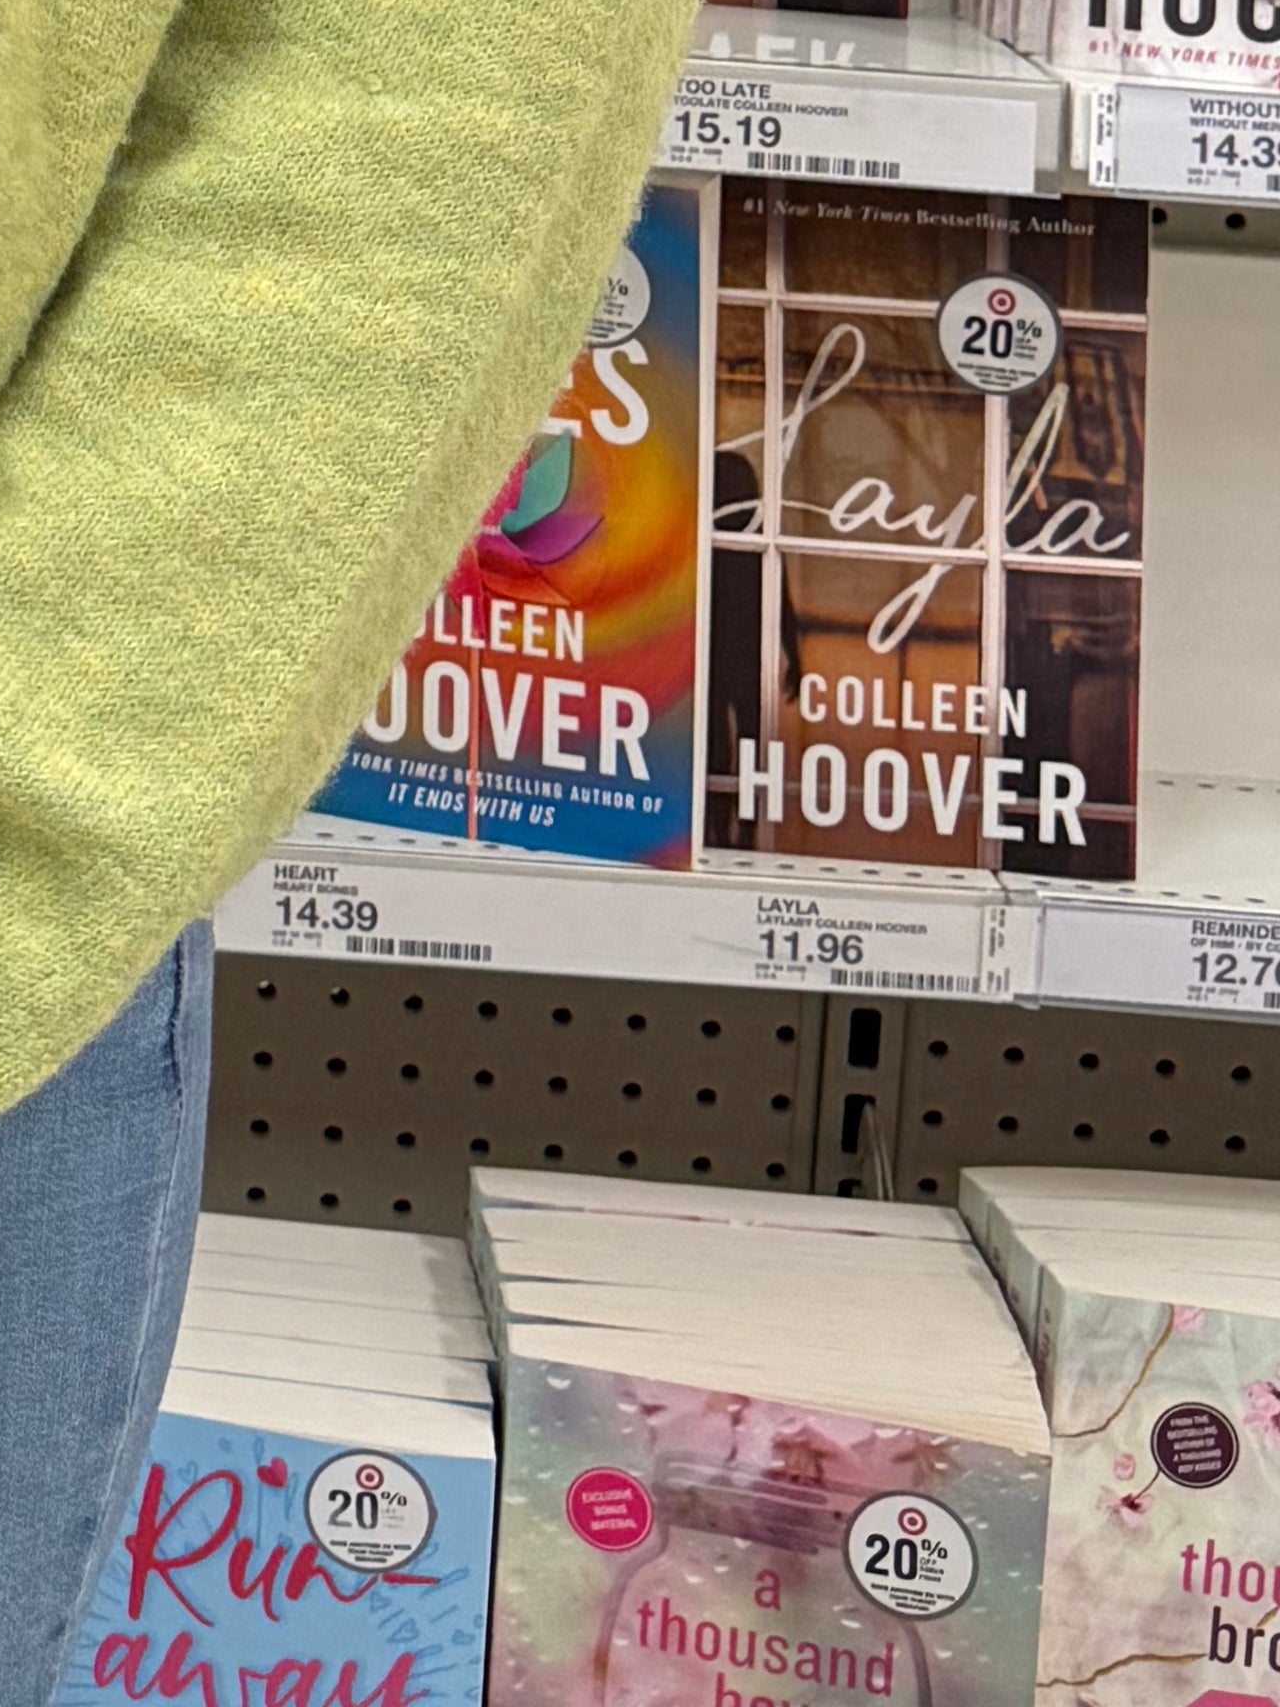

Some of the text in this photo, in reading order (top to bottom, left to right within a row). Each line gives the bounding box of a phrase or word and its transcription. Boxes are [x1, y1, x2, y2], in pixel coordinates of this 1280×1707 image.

[1122, 42, 1216, 63] NEW YORK
[722, 81, 770, 99] LATE
[733, 98, 848, 116] COLLEEN HOOVER
[674, 112, 781, 148] 15.19
[772, 201, 1096, 238] New York Times Bestselling Author
[962, 316, 1042, 359] 20%
[714, 323, 1130, 654] Layla
[800, 673, 1028, 738] COLLEEN
[388, 783, 555, 827] IT ENDS WITH US
[400, 759, 663, 814] TIMES BESTSELLING AUTHOR OF
[738, 736, 1088, 846] HOOVER
[275, 865, 337, 882] HEART
[276, 897, 377, 931] 14.39
[758, 897, 819, 916] LAYLA
[816, 918, 927, 934] COLLEEN HOOVER
[758, 932, 863, 963] 11.96
[865, 1533, 947, 1580] 20%
[754, 1570, 781, 1610] a
[637, 1598, 893, 1696] thousand
